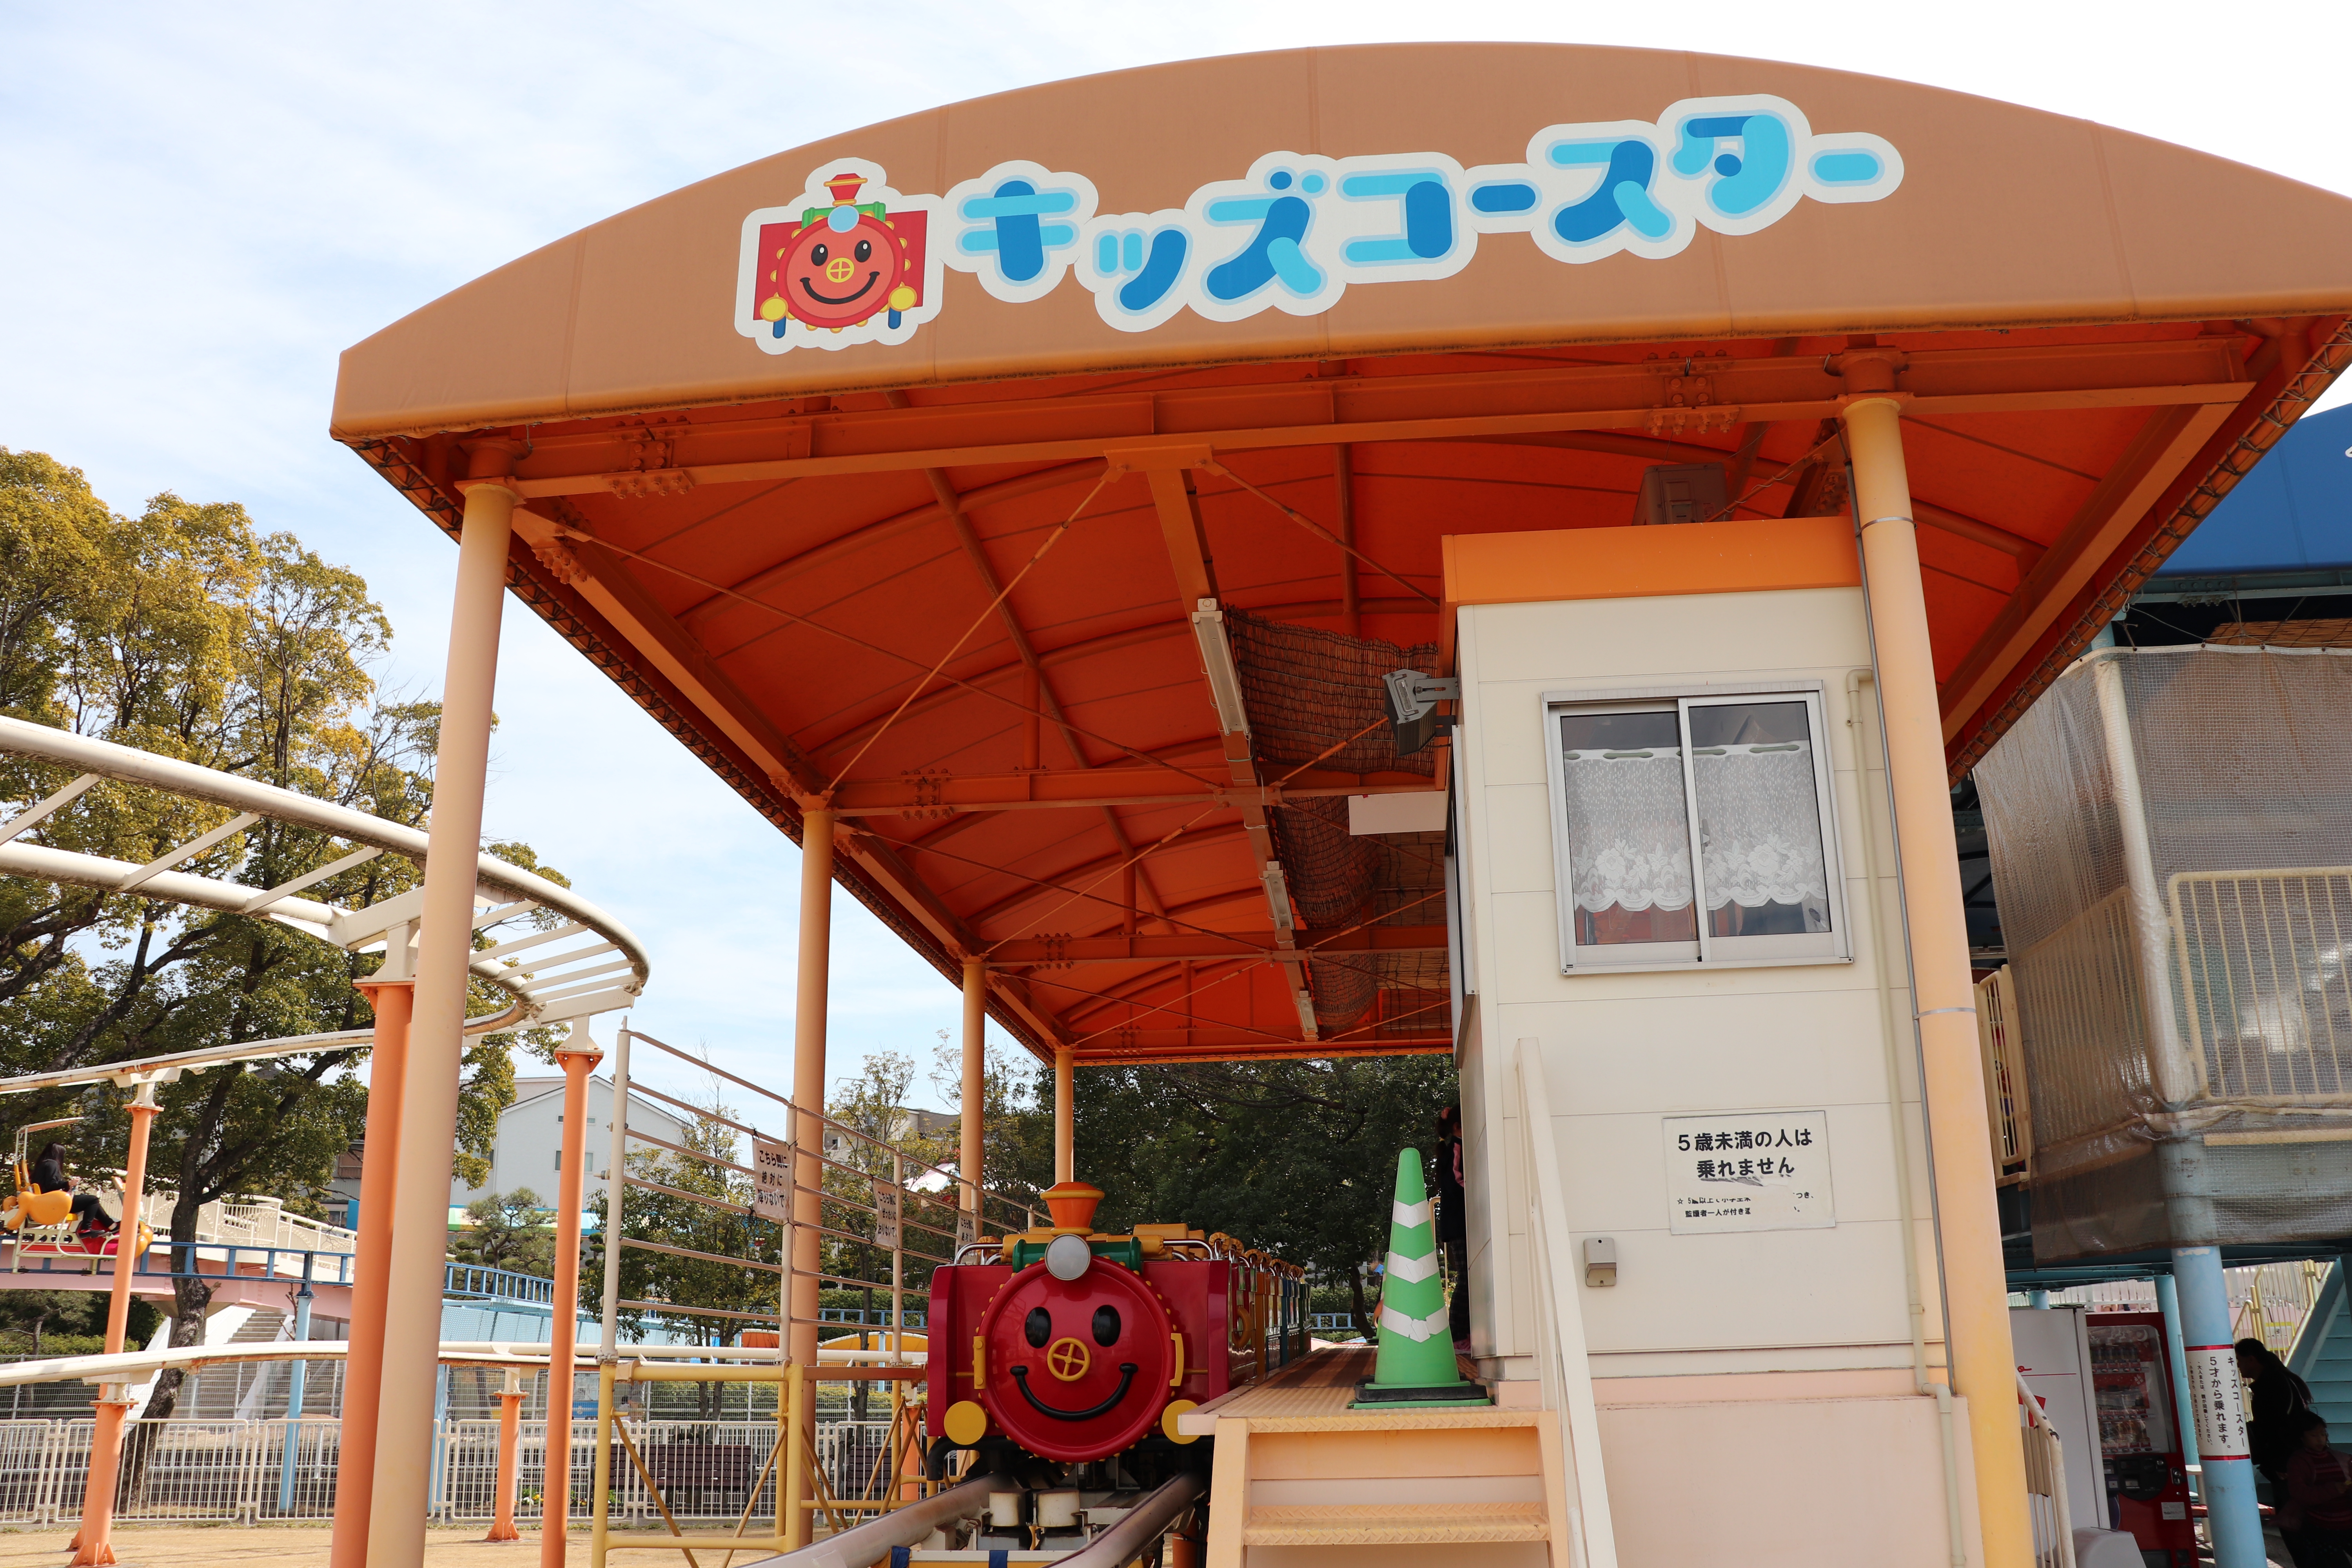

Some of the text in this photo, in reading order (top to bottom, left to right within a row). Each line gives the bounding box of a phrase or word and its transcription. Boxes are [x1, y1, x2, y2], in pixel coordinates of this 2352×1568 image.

[956, 112, 1882, 312] キッズコースター
[1678, 1128, 1813, 1152] 5歳未満の人は
[759, 1150, 788, 1168] こちら側に
[1696, 1156, 1795, 1178] 乗れません
[762, 1170, 782, 1186] 絶対に
[2209, 1356, 2231, 1448] 5才から乗れます。
[2227, 1356, 2245, 1447] キッズコースター
